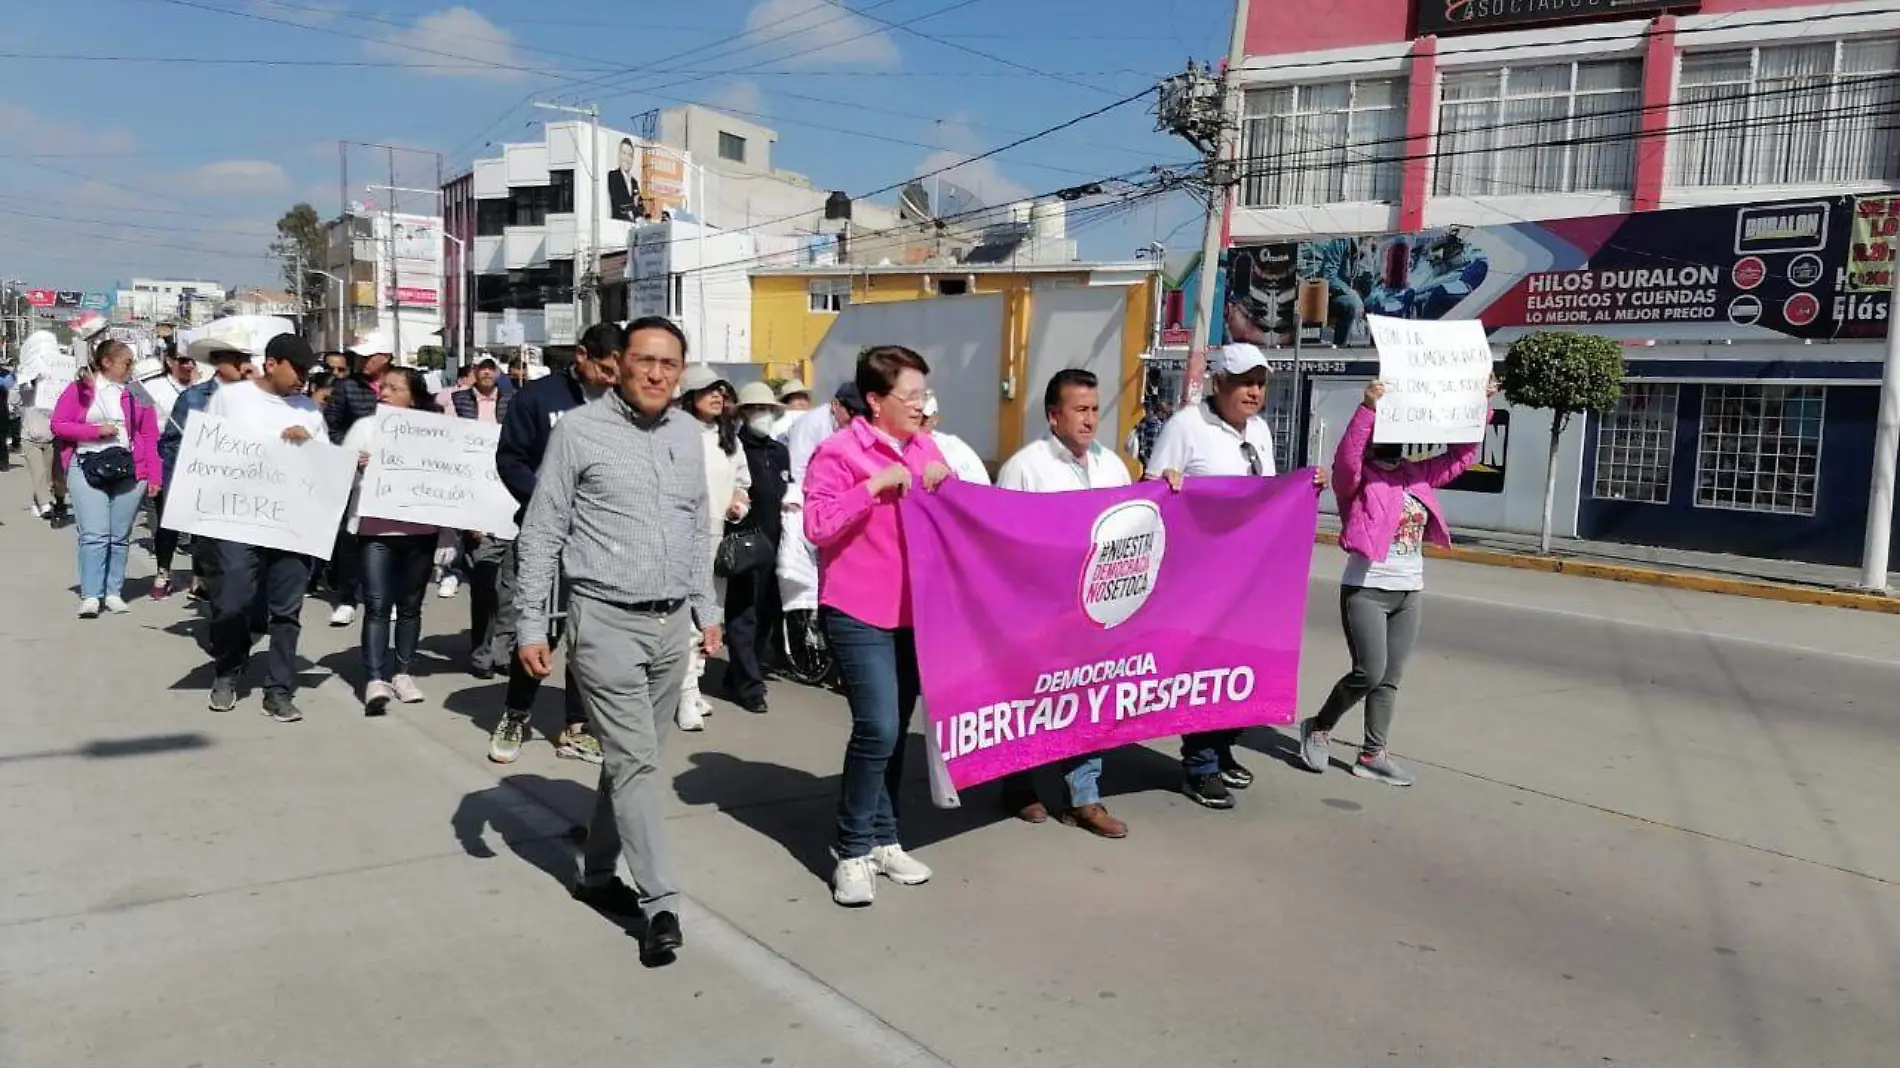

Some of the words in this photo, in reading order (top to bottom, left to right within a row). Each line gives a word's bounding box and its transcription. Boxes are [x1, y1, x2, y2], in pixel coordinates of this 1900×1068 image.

[1462, 0, 1599, 21] ASOCIA
[1528, 272, 1594, 293] HILOS
[1601, 266, 1719, 290] DURALON
[1615, 294, 1627, 308] Y
[1631, 288, 1717, 305] CUENDAS
[1832, 294, 1888, 320] Elás
[1525, 311, 1542, 323] LO
[1546, 310, 1592, 323] MEJOR,
[1595, 309, 1611, 321] AL
[1616, 308, 1660, 320] MEJOR
[1664, 306, 1716, 320] PRECIO
[381, 447, 405, 466] las
[375, 476, 392, 499] la
[196, 488, 287, 523] LIBRE
[1034, 653, 1157, 694] DEMOCRACIA
[936, 693, 1080, 761] LIBERTAD
[1088, 684, 1109, 723] Y
[1115, 665, 1255, 720] RESPETO
